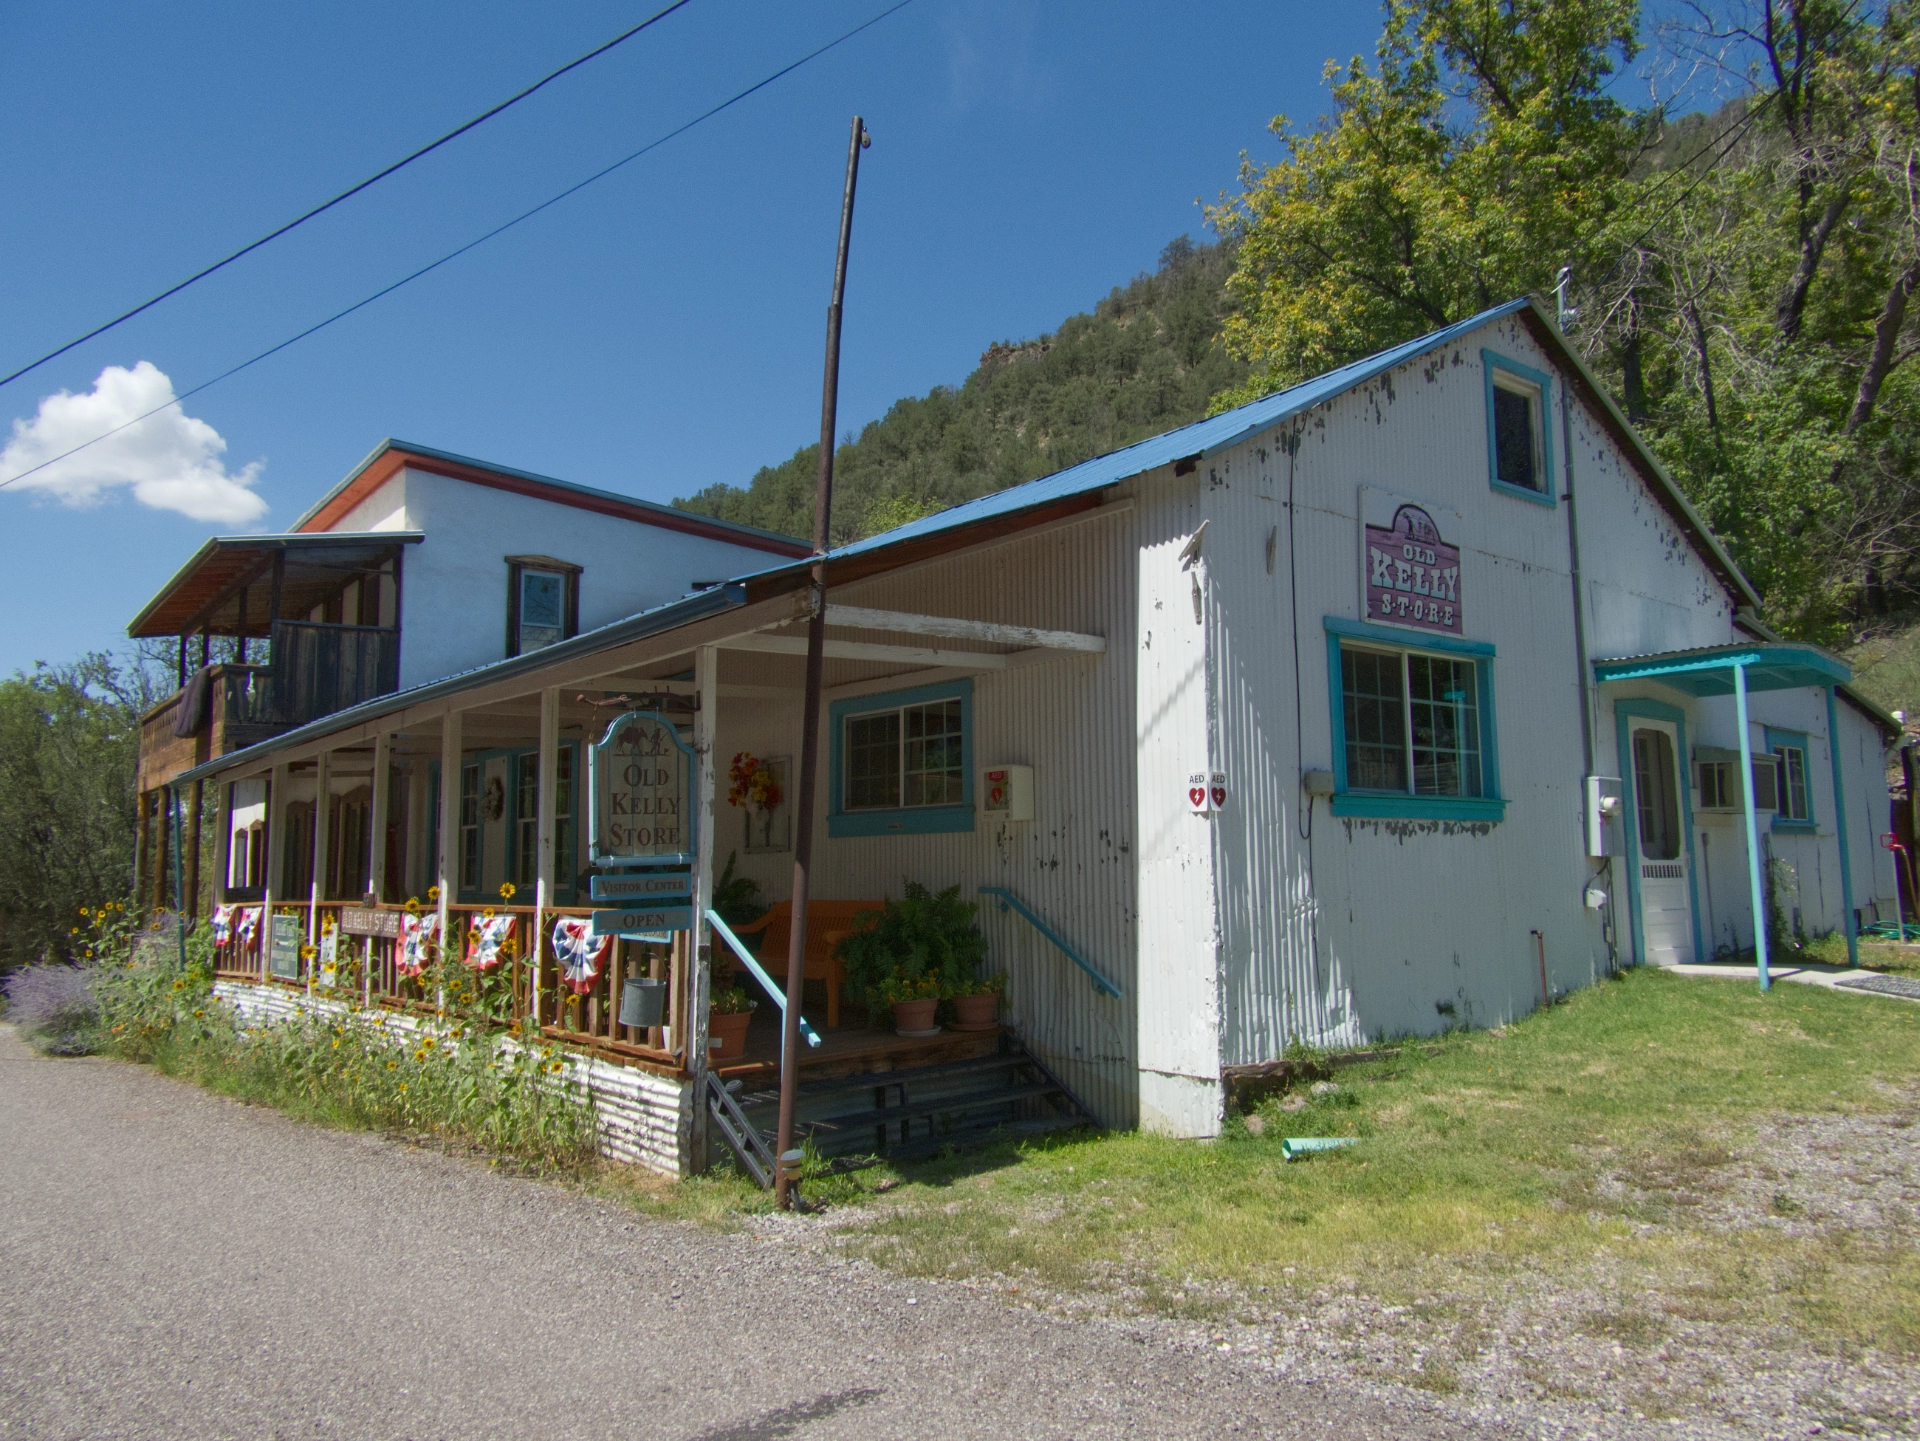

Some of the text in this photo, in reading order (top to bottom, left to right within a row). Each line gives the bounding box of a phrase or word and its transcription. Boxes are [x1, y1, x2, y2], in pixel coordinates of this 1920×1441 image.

[1402, 544, 1436, 566] OLD
[1370, 545, 1458, 603] KELLY
[1189, 774, 1205, 784] AED
[1211, 774, 1226, 784] AED
[353, 911, 373, 930] KELLY
[374, 913, 399, 933] STORE
